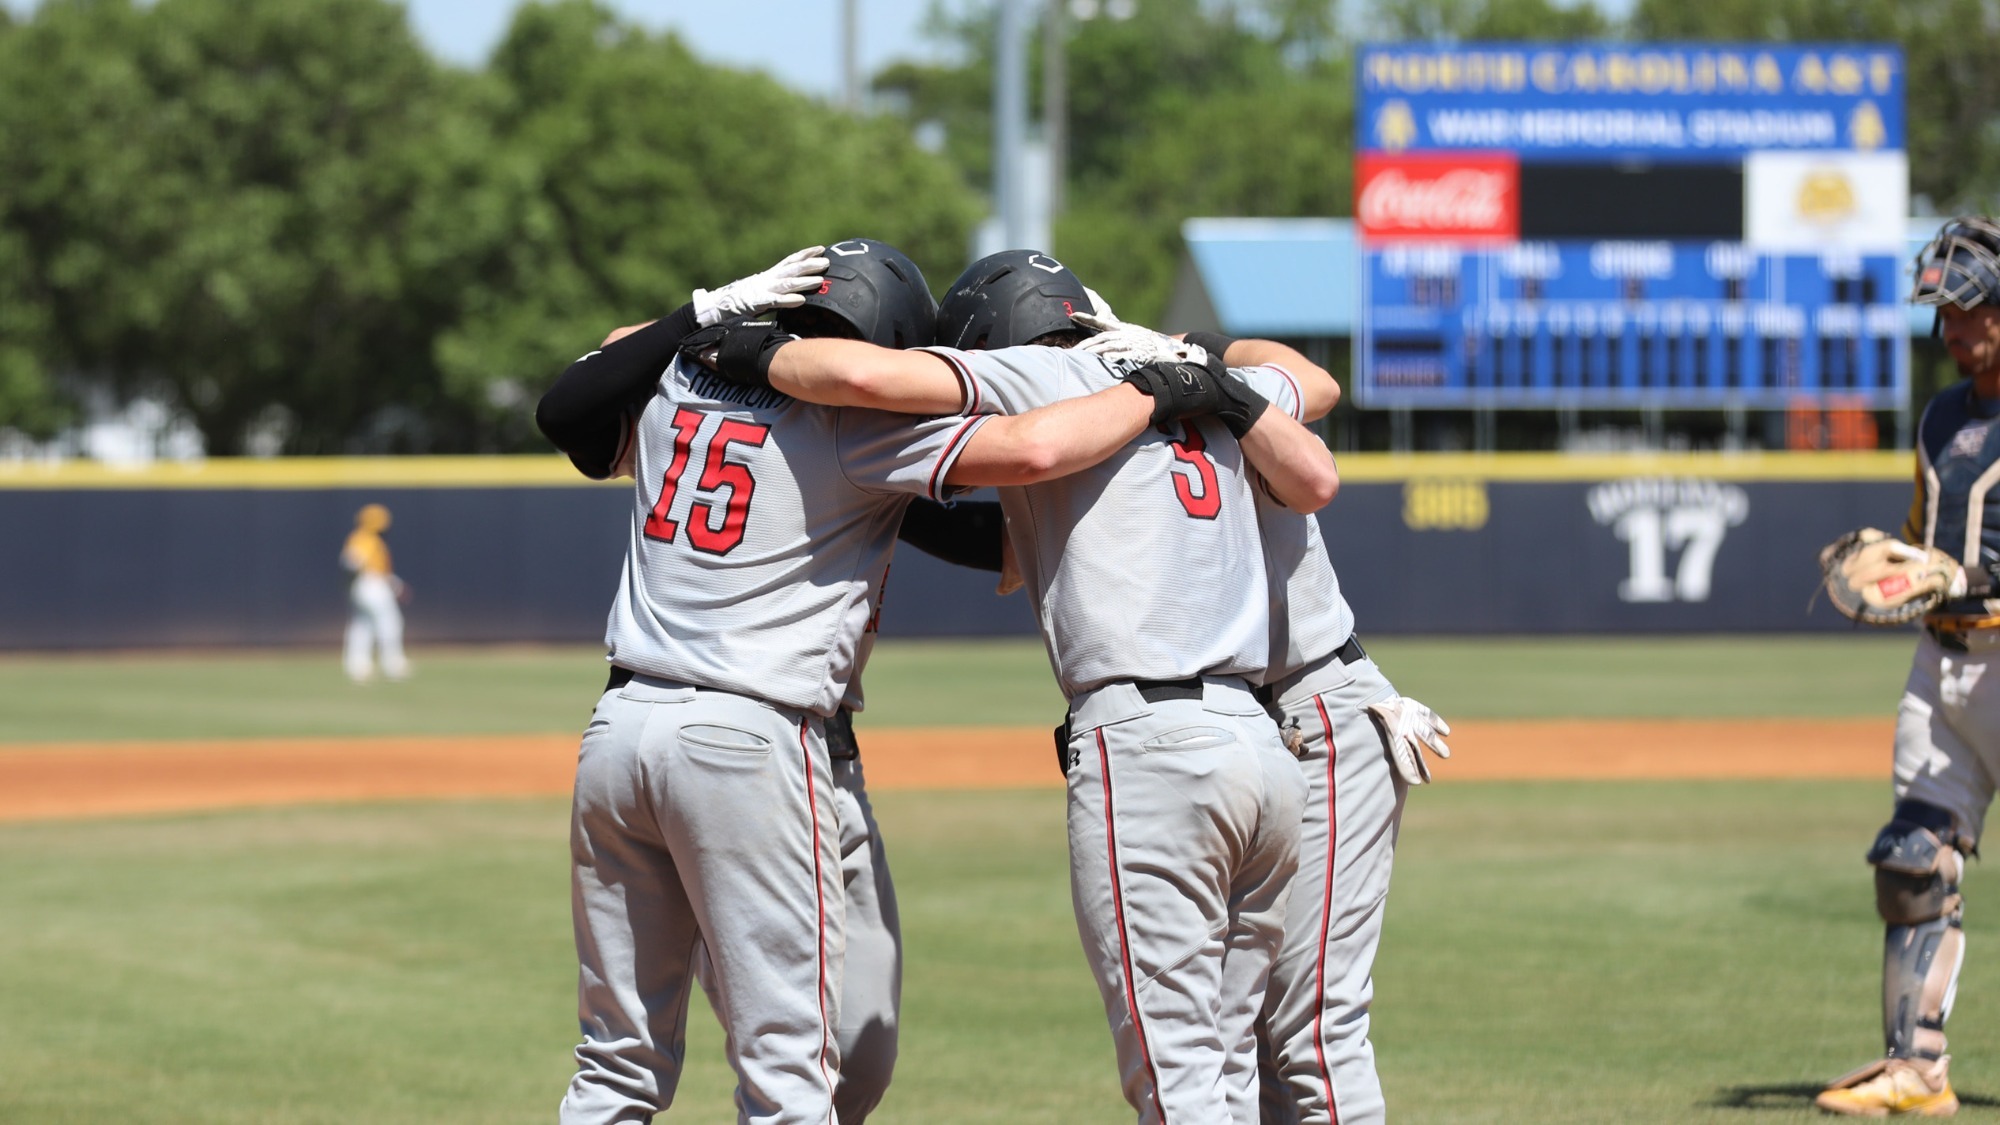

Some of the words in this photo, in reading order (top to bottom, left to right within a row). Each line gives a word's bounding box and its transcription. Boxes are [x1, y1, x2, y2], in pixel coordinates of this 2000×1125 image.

[1366, 54, 1521, 92] NORTH
[1534, 53, 1783, 93] CAROLINA
[1795, 53, 1895, 94] A&T
[1430, 110, 1510, 145] WAR
[1517, 111, 1684, 146] MEMORIAL
[1693, 112, 1836, 147] STADIUM
[1360, 168, 1506, 228] Coca-Cola
[643, 404, 772, 557] 15
[1156, 418, 1222, 520] 3
[1615, 506, 1726, 602] 17
